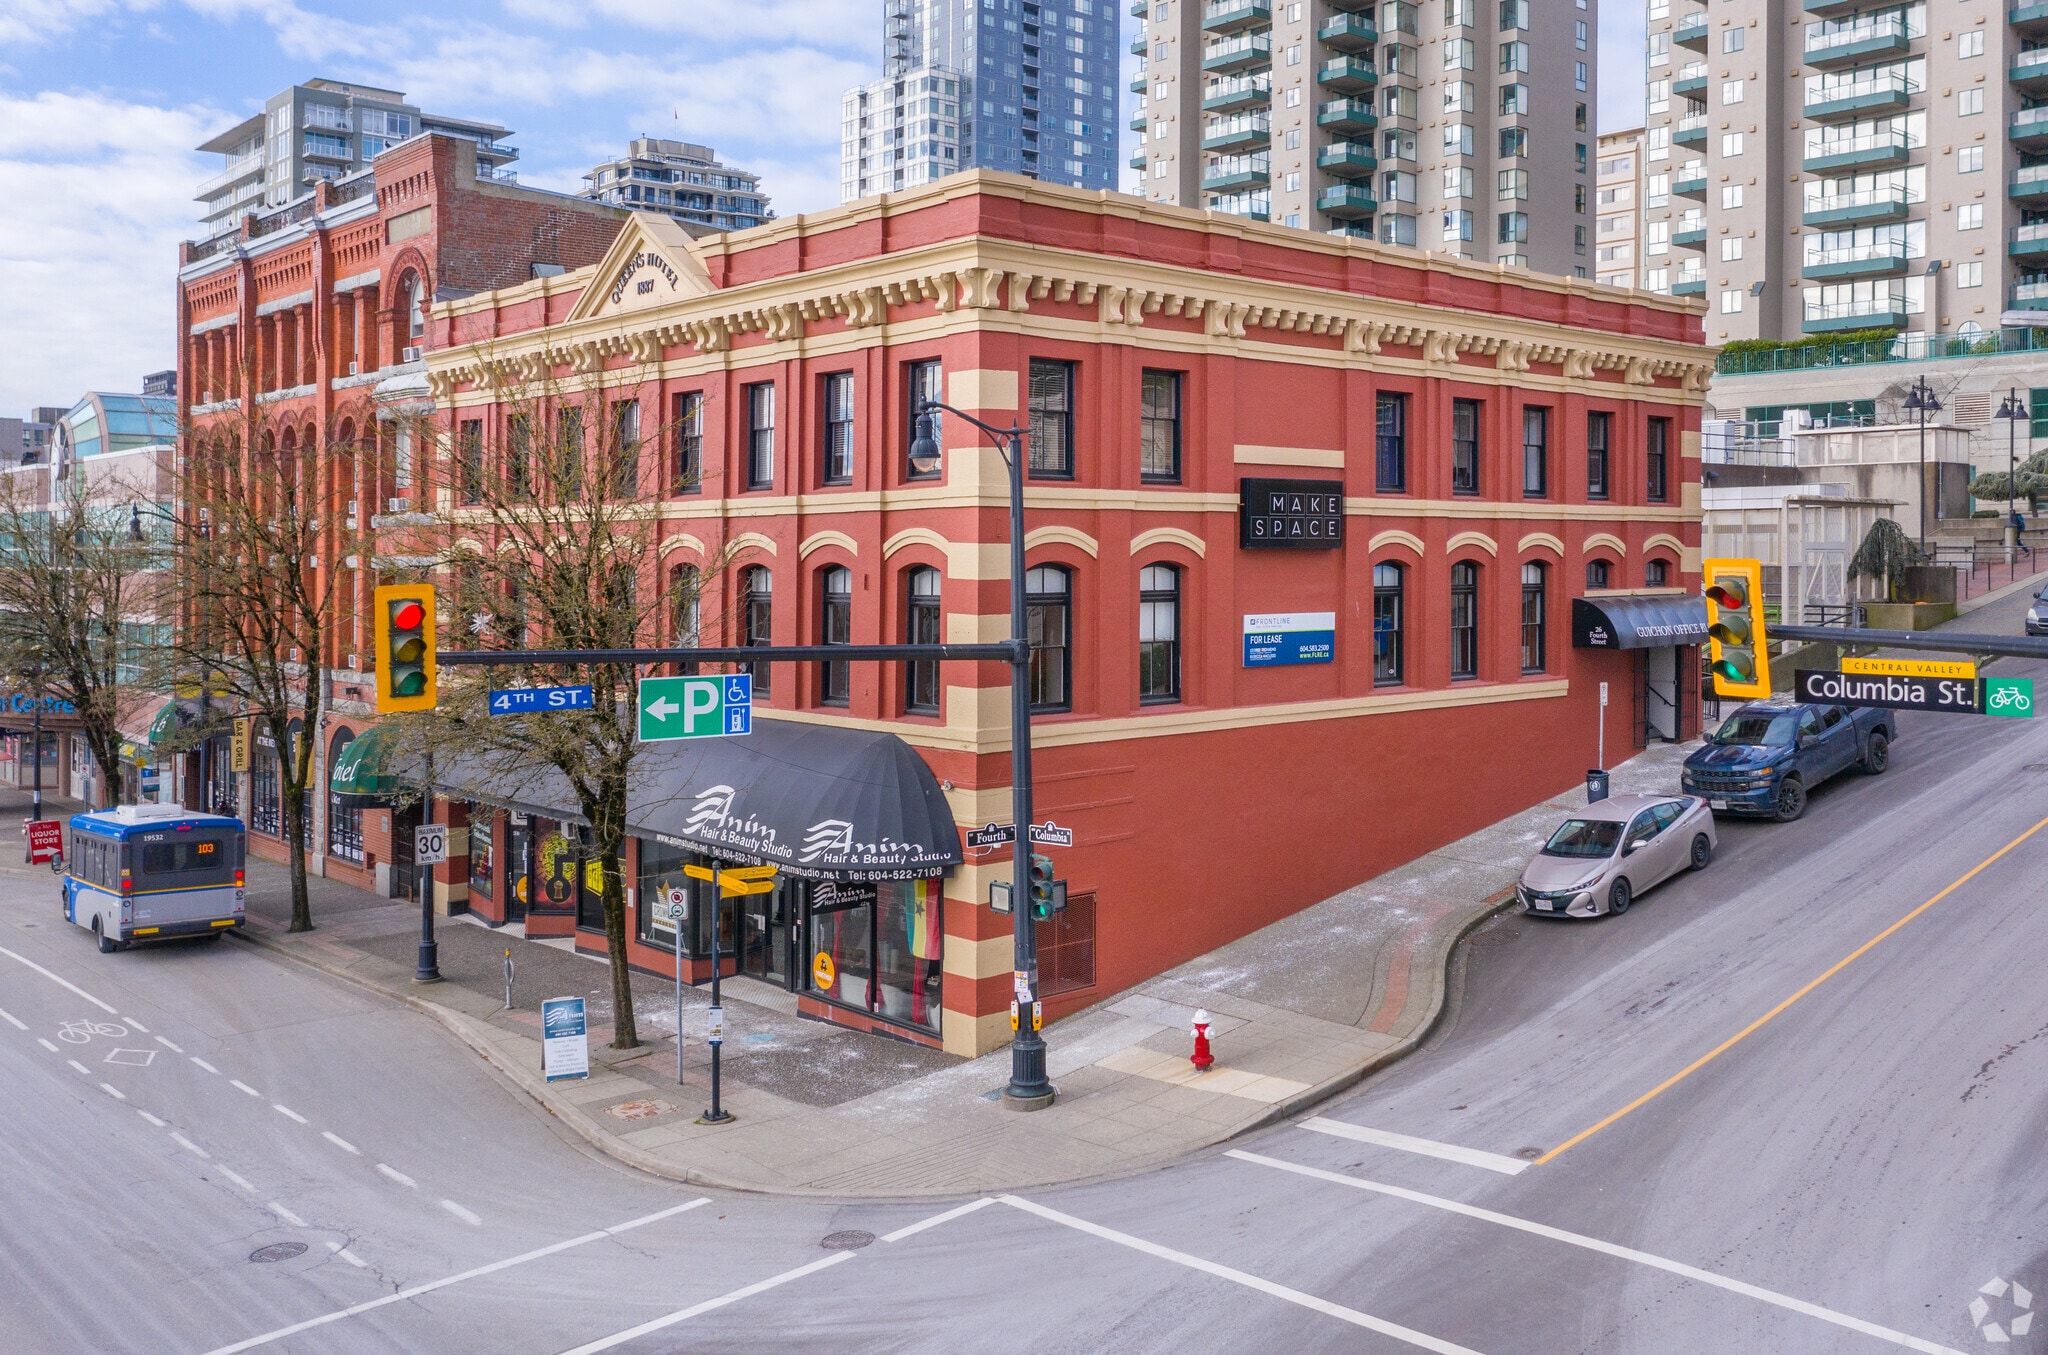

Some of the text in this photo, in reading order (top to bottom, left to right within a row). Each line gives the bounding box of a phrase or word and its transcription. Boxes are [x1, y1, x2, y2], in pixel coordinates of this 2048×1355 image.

[611, 252, 679, 305] QUEEN'S HOTEL
[637, 279, 655, 295] 1887
[1272, 496, 1336, 513] MAKE
[1255, 519, 1336, 536] SPACE
[1256, 617, 1291, 626] FRONTLINE
[1250, 634, 1283, 644] FOR LEASE
[1636, 627, 1674, 638] GUICHON
[1674, 624, 1700, 635] OFFICE
[1854, 662, 1962, 674] CENTRAL VALLEY
[1806, 674, 1972, 705] Columbia St.
[494, 690, 589, 710] 4TH ST.
[683, 681, 720, 734] P
[235, 721, 243, 737] BAR
[235, 747, 243, 768] GRILL
[688, 785, 776, 841] Anim
[31, 830, 60, 838] LIQUOR
[34, 837, 58, 845] STORE
[701, 826, 793, 858] Hair & Beauty Studio
[804, 819, 923, 858] Anim
[977, 830, 1007, 843] Fourth
[1035, 829, 1068, 842] Columbia
[198, 844, 214, 853] 103
[418, 835, 442, 854] 30
[824, 853, 847, 863] Hair
[850, 854, 858, 863] &
[863, 852, 906, 864] Beauty
[848, 870, 866, 880] Tel:
[868, 866, 942, 880] 604-522-7108
[815, 882, 865, 900] Anim
[841, 895, 859, 903] Beauty
[859, 892, 876, 900] Studio
